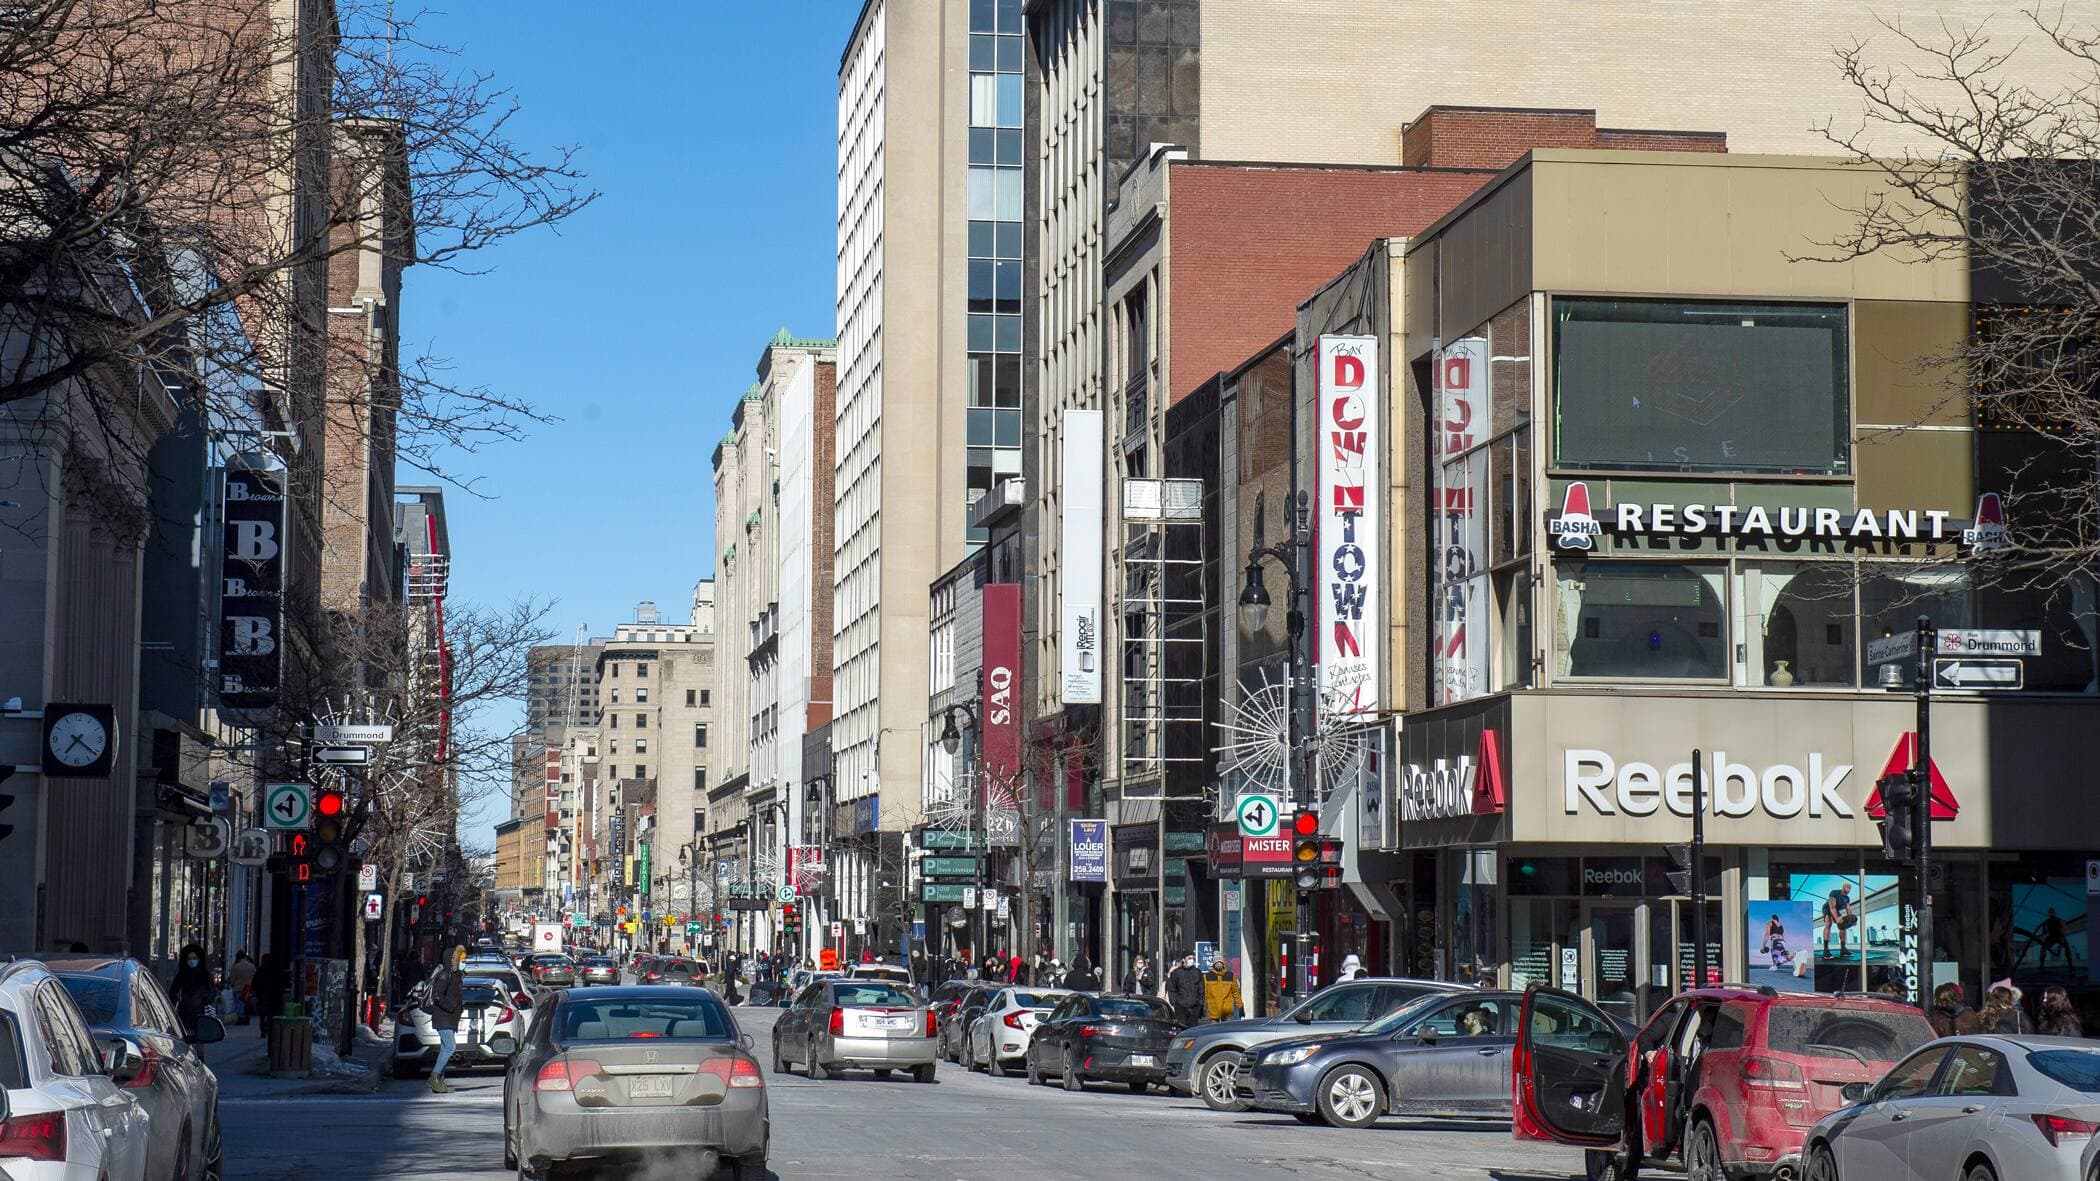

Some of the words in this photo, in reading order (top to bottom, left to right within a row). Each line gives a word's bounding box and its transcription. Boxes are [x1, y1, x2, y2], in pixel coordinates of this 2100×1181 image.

[1552, 520, 1600, 535] BASHA
[1616, 503, 1950, 539] RESTAURANT
[228, 520, 278, 560] B
[225, 616, 275, 656] B
[1968, 639, 2036, 651] Drummond
[990, 666, 1012, 725] SAQ
[332, 731, 385, 739] Drummond
[1401, 756, 1476, 821] Reebok
[1564, 750, 1854, 818] Reebok
[1074, 842, 1104, 851] LOUER
[1248, 840, 1290, 852] MISTER
[1583, 868, 1642, 884] Reebok
